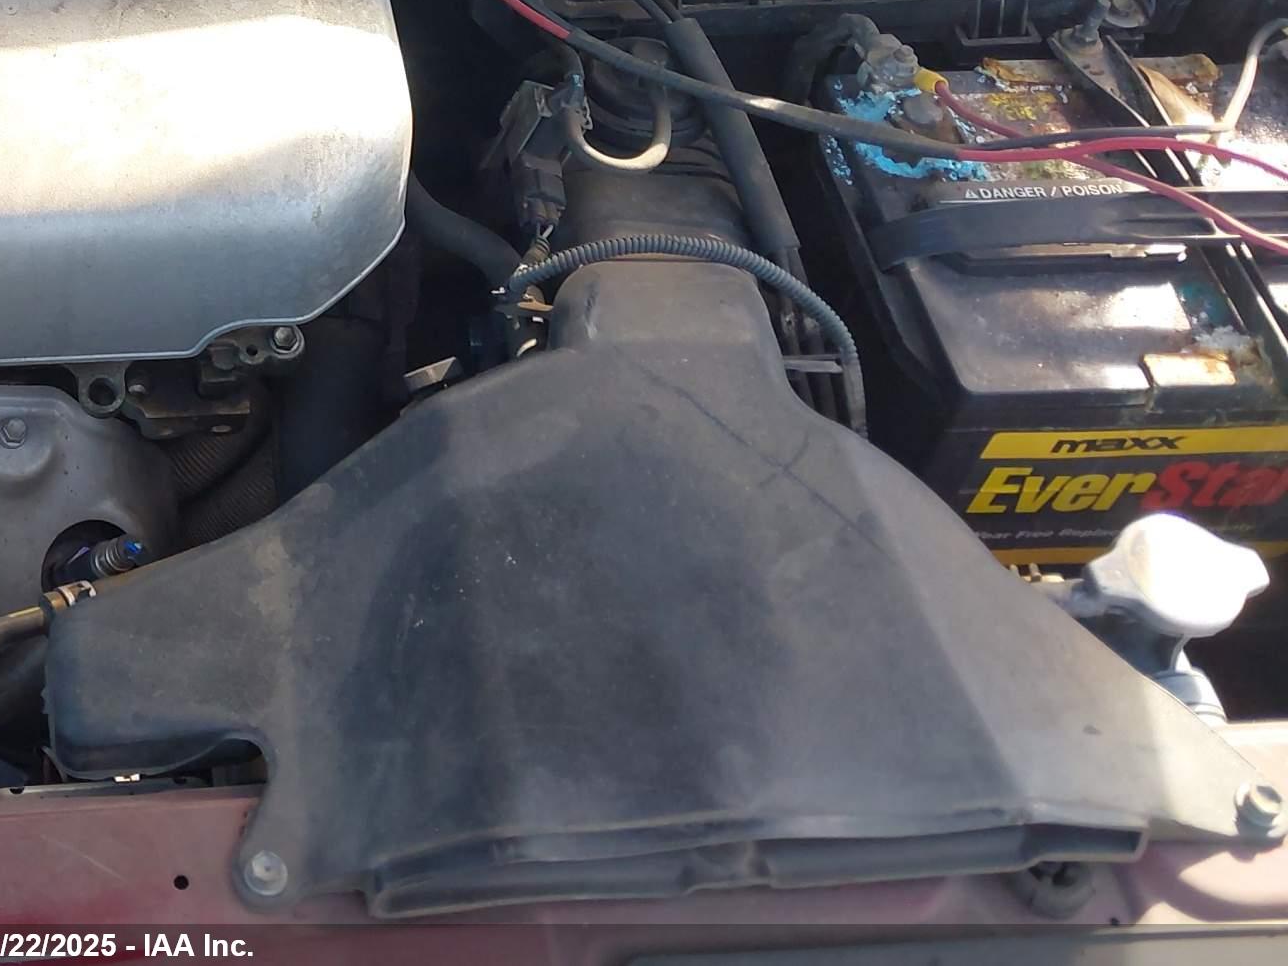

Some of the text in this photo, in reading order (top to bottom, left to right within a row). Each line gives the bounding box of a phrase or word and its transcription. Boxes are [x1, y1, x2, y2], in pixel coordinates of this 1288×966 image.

[979, 184, 1122, 199] DANGER / POISON
[1051, 436, 1187, 453] maxx
